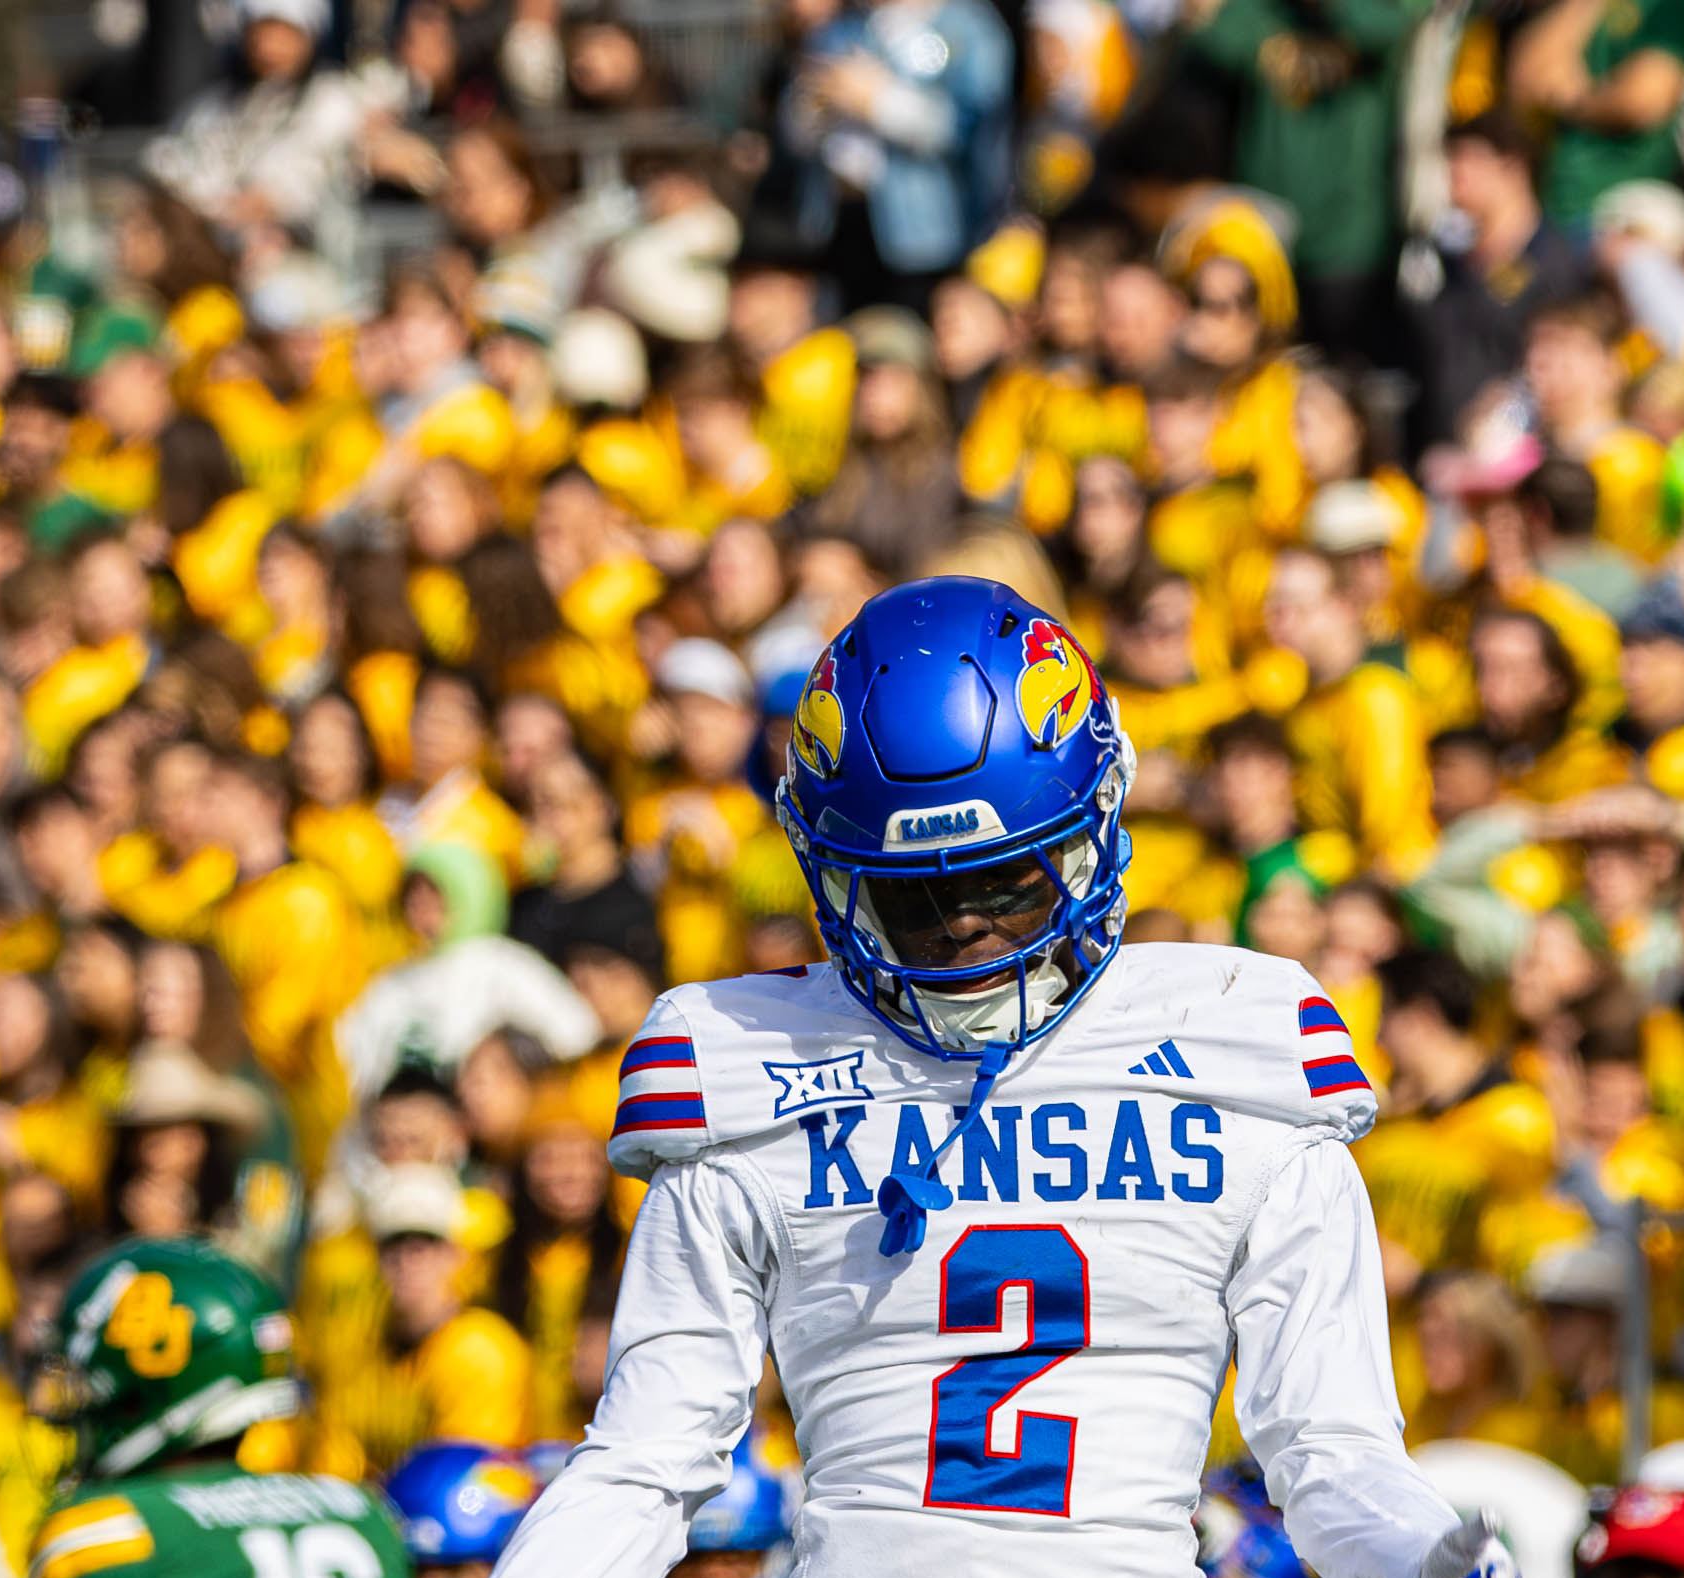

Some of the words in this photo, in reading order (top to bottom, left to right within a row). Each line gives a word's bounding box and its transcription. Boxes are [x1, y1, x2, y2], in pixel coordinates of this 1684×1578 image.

[900, 808, 980, 841] KANSAS
[803, 1100, 1224, 1208] KANSAS
[923, 1223, 1091, 1518] 2
